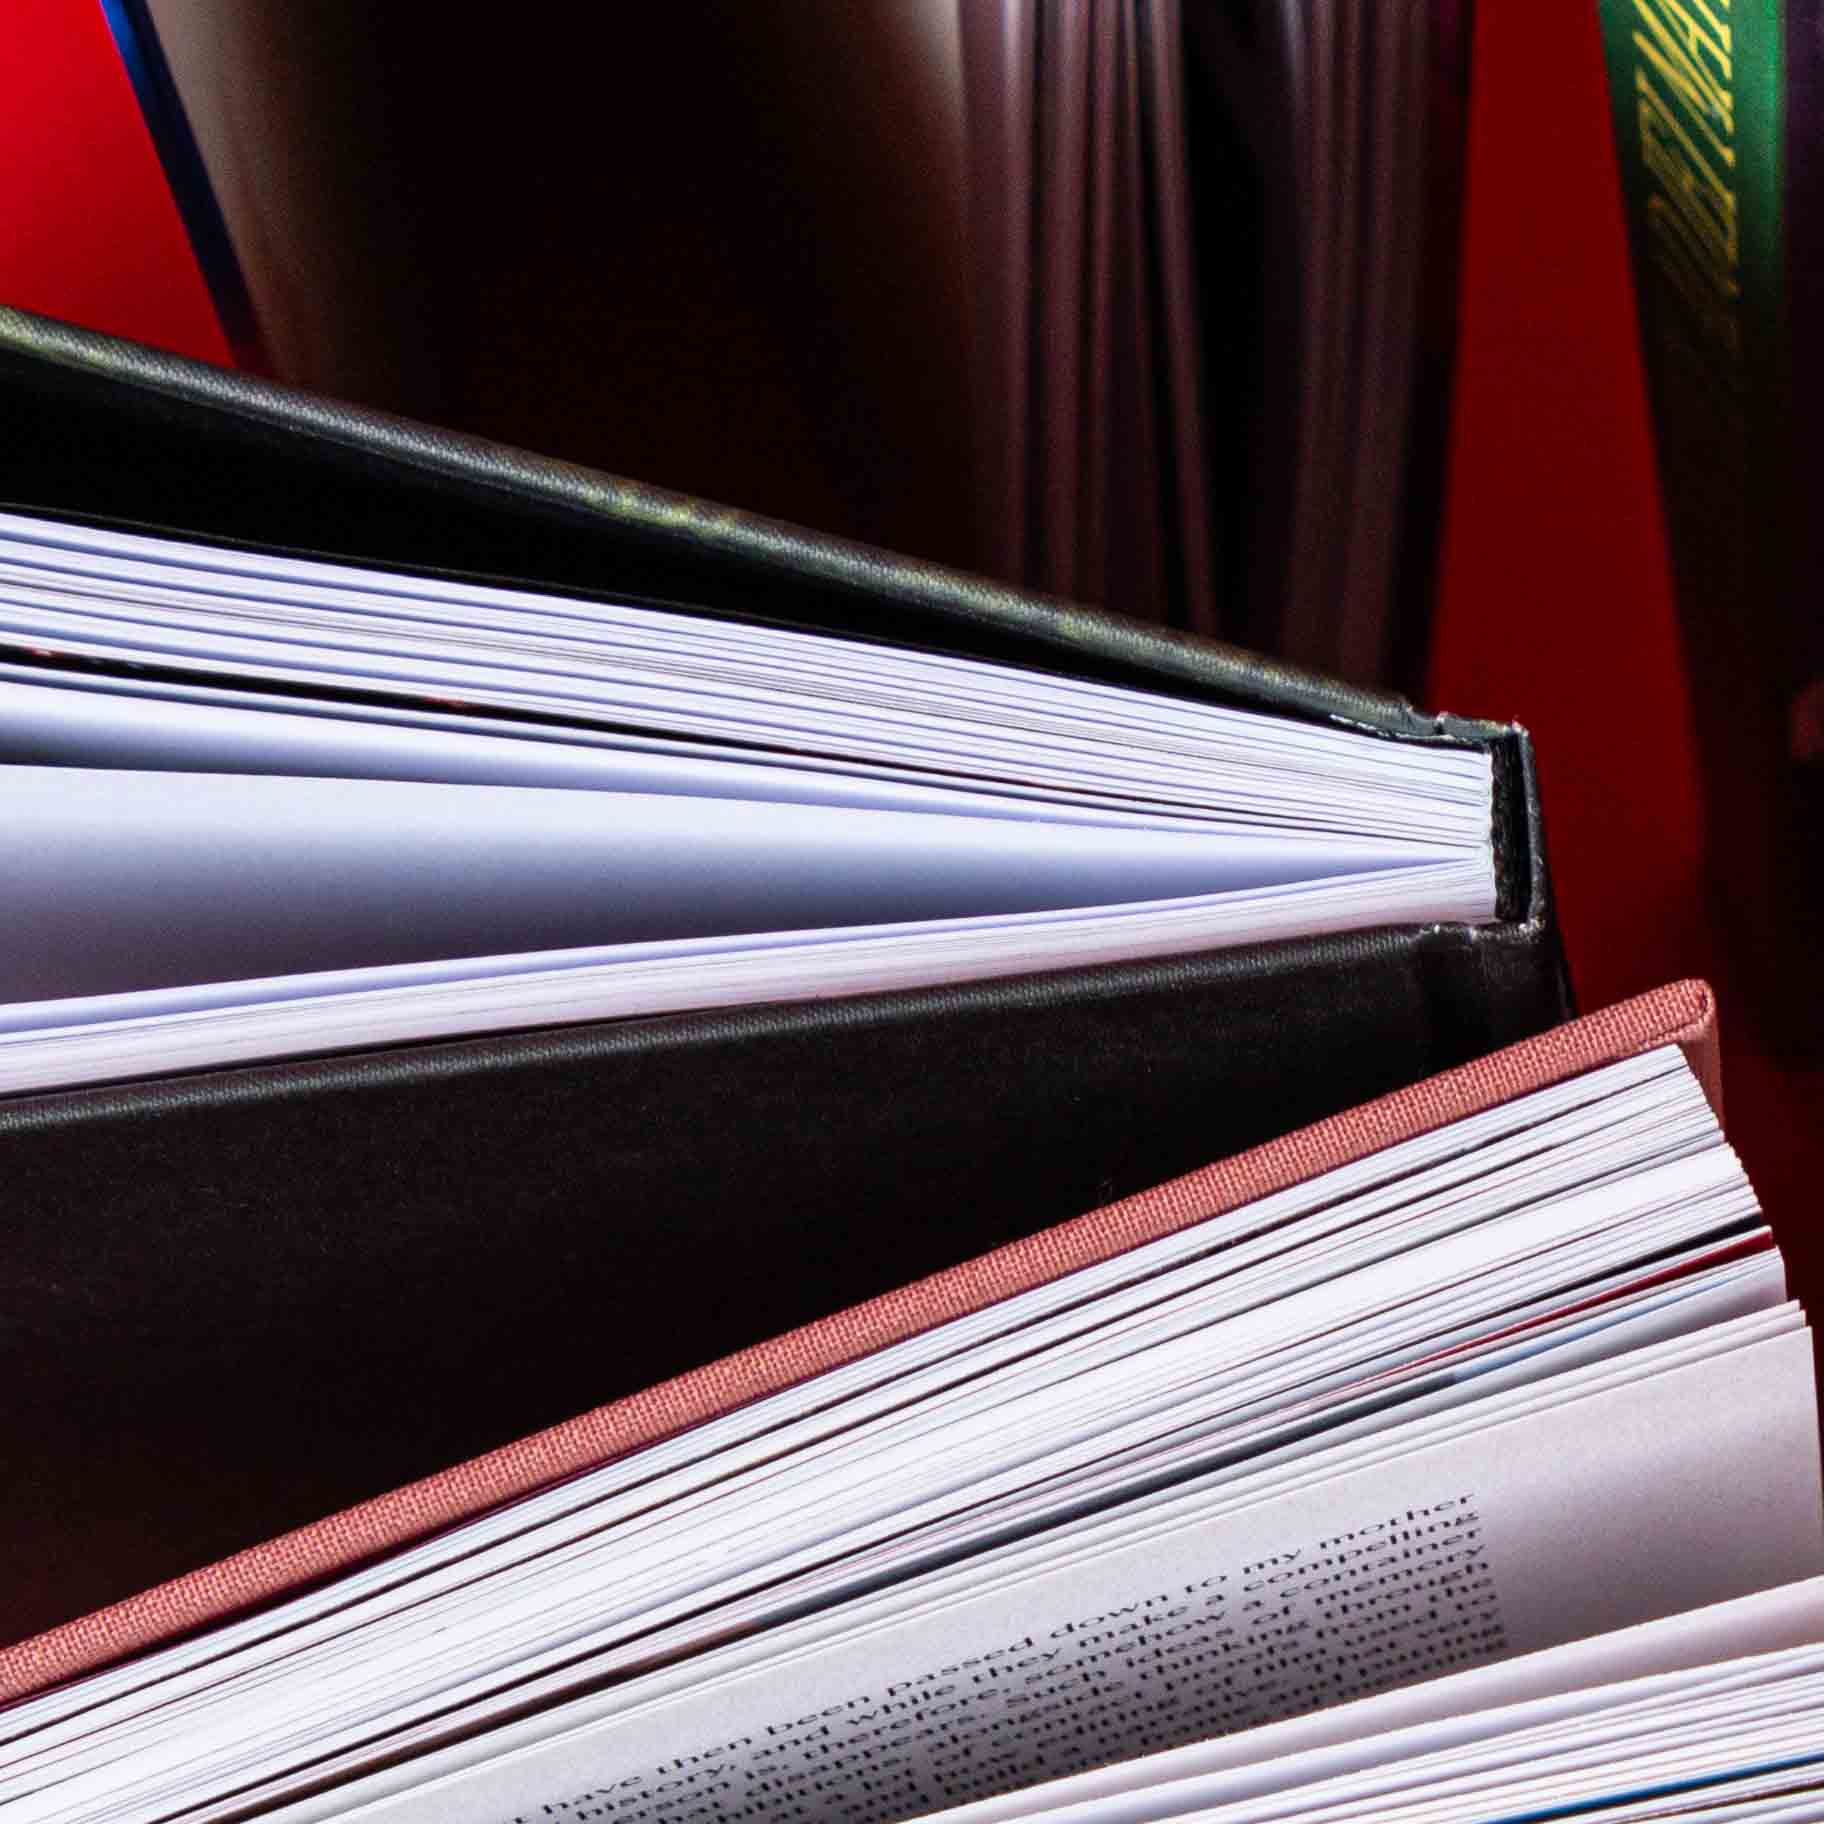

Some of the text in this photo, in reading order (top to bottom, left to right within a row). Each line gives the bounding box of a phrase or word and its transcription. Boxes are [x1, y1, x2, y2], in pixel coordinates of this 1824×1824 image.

[541, 1775, 644, 1816] have
[655, 1736, 754, 1777] then
[764, 1695, 872, 1737] been
[885, 1636, 1036, 1698] passed
[1048, 1593, 1169, 1640] down
[1183, 1574, 1229, 1596] to
[1241, 1548, 1302, 1576] my
[1319, 1493, 1475, 1551] mother
[575, 1762, 738, 1823] history,
[750, 1724, 832, 1762] and
[844, 1683, 957, 1728] while
[971, 1647, 1063, 1686] they
[1076, 1605, 1190, 1650] make
[1204, 1593, 1227, 1608] a
[1242, 1511, 1481, 1594] compelling
[1004, 1669, 1108, 1710] Such
[1124, 1626, 1236, 1670] ideas
[1250, 1604, 1292, 1628] of
[1313, 1543, 1486, 1608] memory
[1023, 1610, 1226, 1686] somehow
[1279, 1527, 1482, 1600] container
